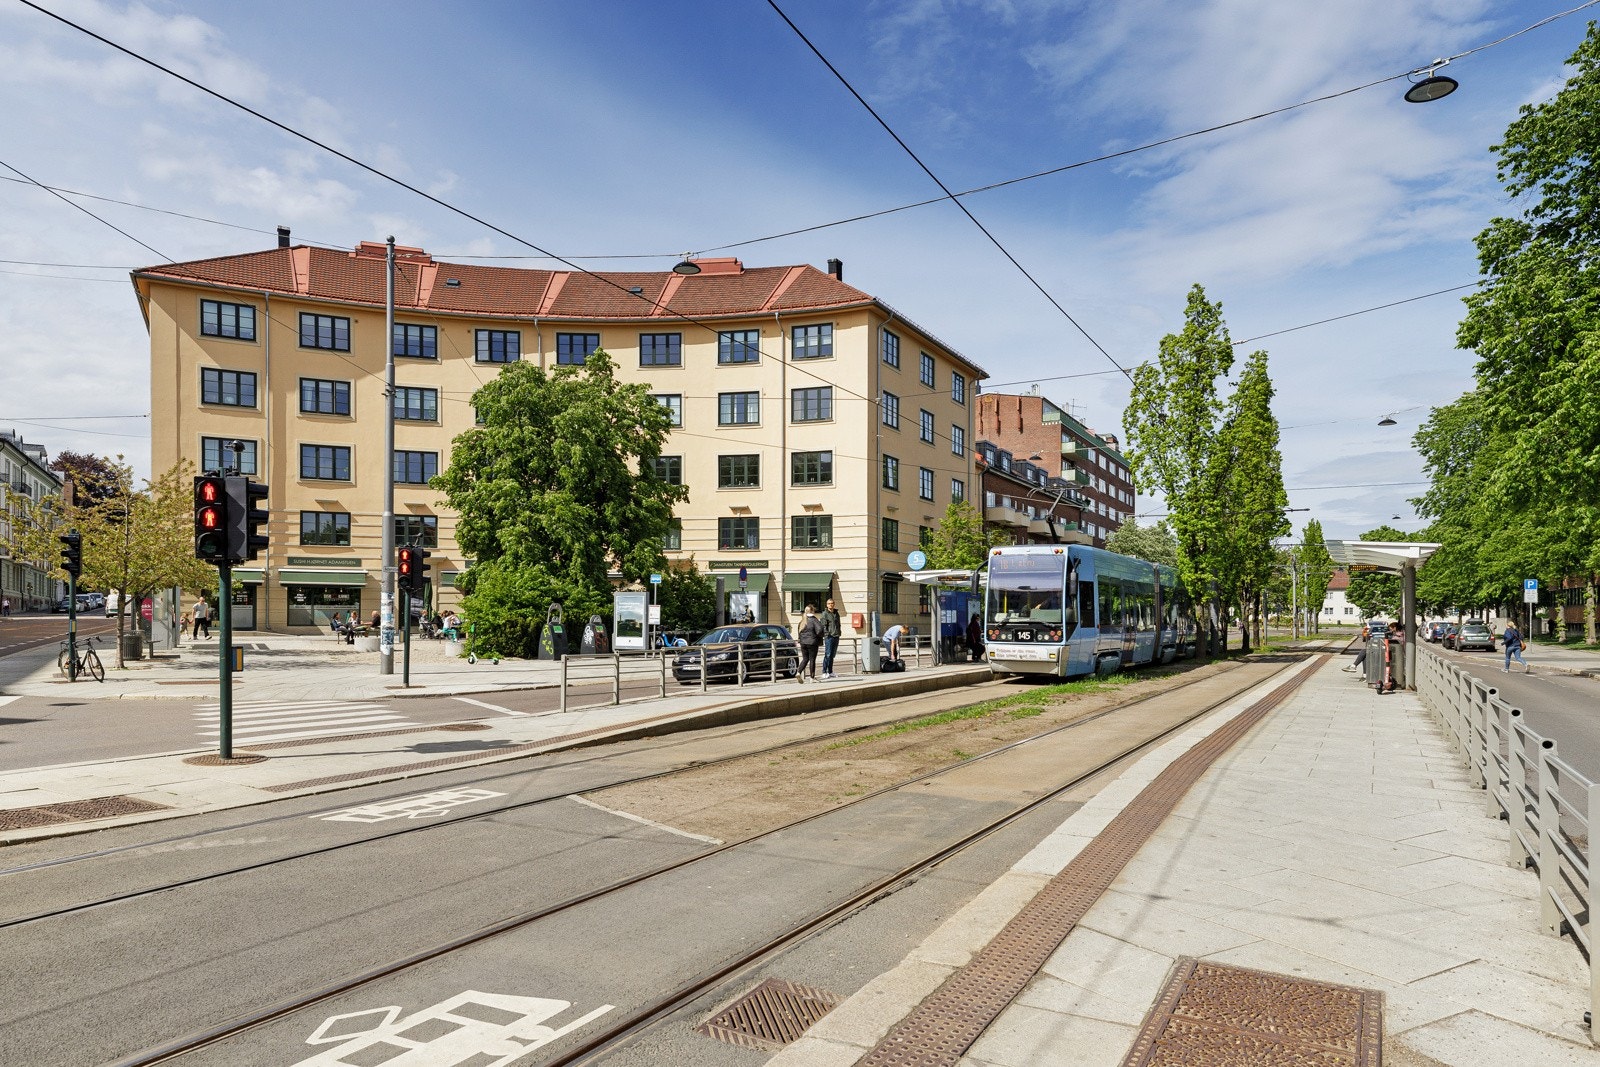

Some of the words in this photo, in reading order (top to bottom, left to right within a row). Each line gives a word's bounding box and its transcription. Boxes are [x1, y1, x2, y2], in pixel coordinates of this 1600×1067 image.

[913, 554, 920, 562] 5
[1527, 580, 1535, 589] P
[1017, 631, 1031, 640] 145
